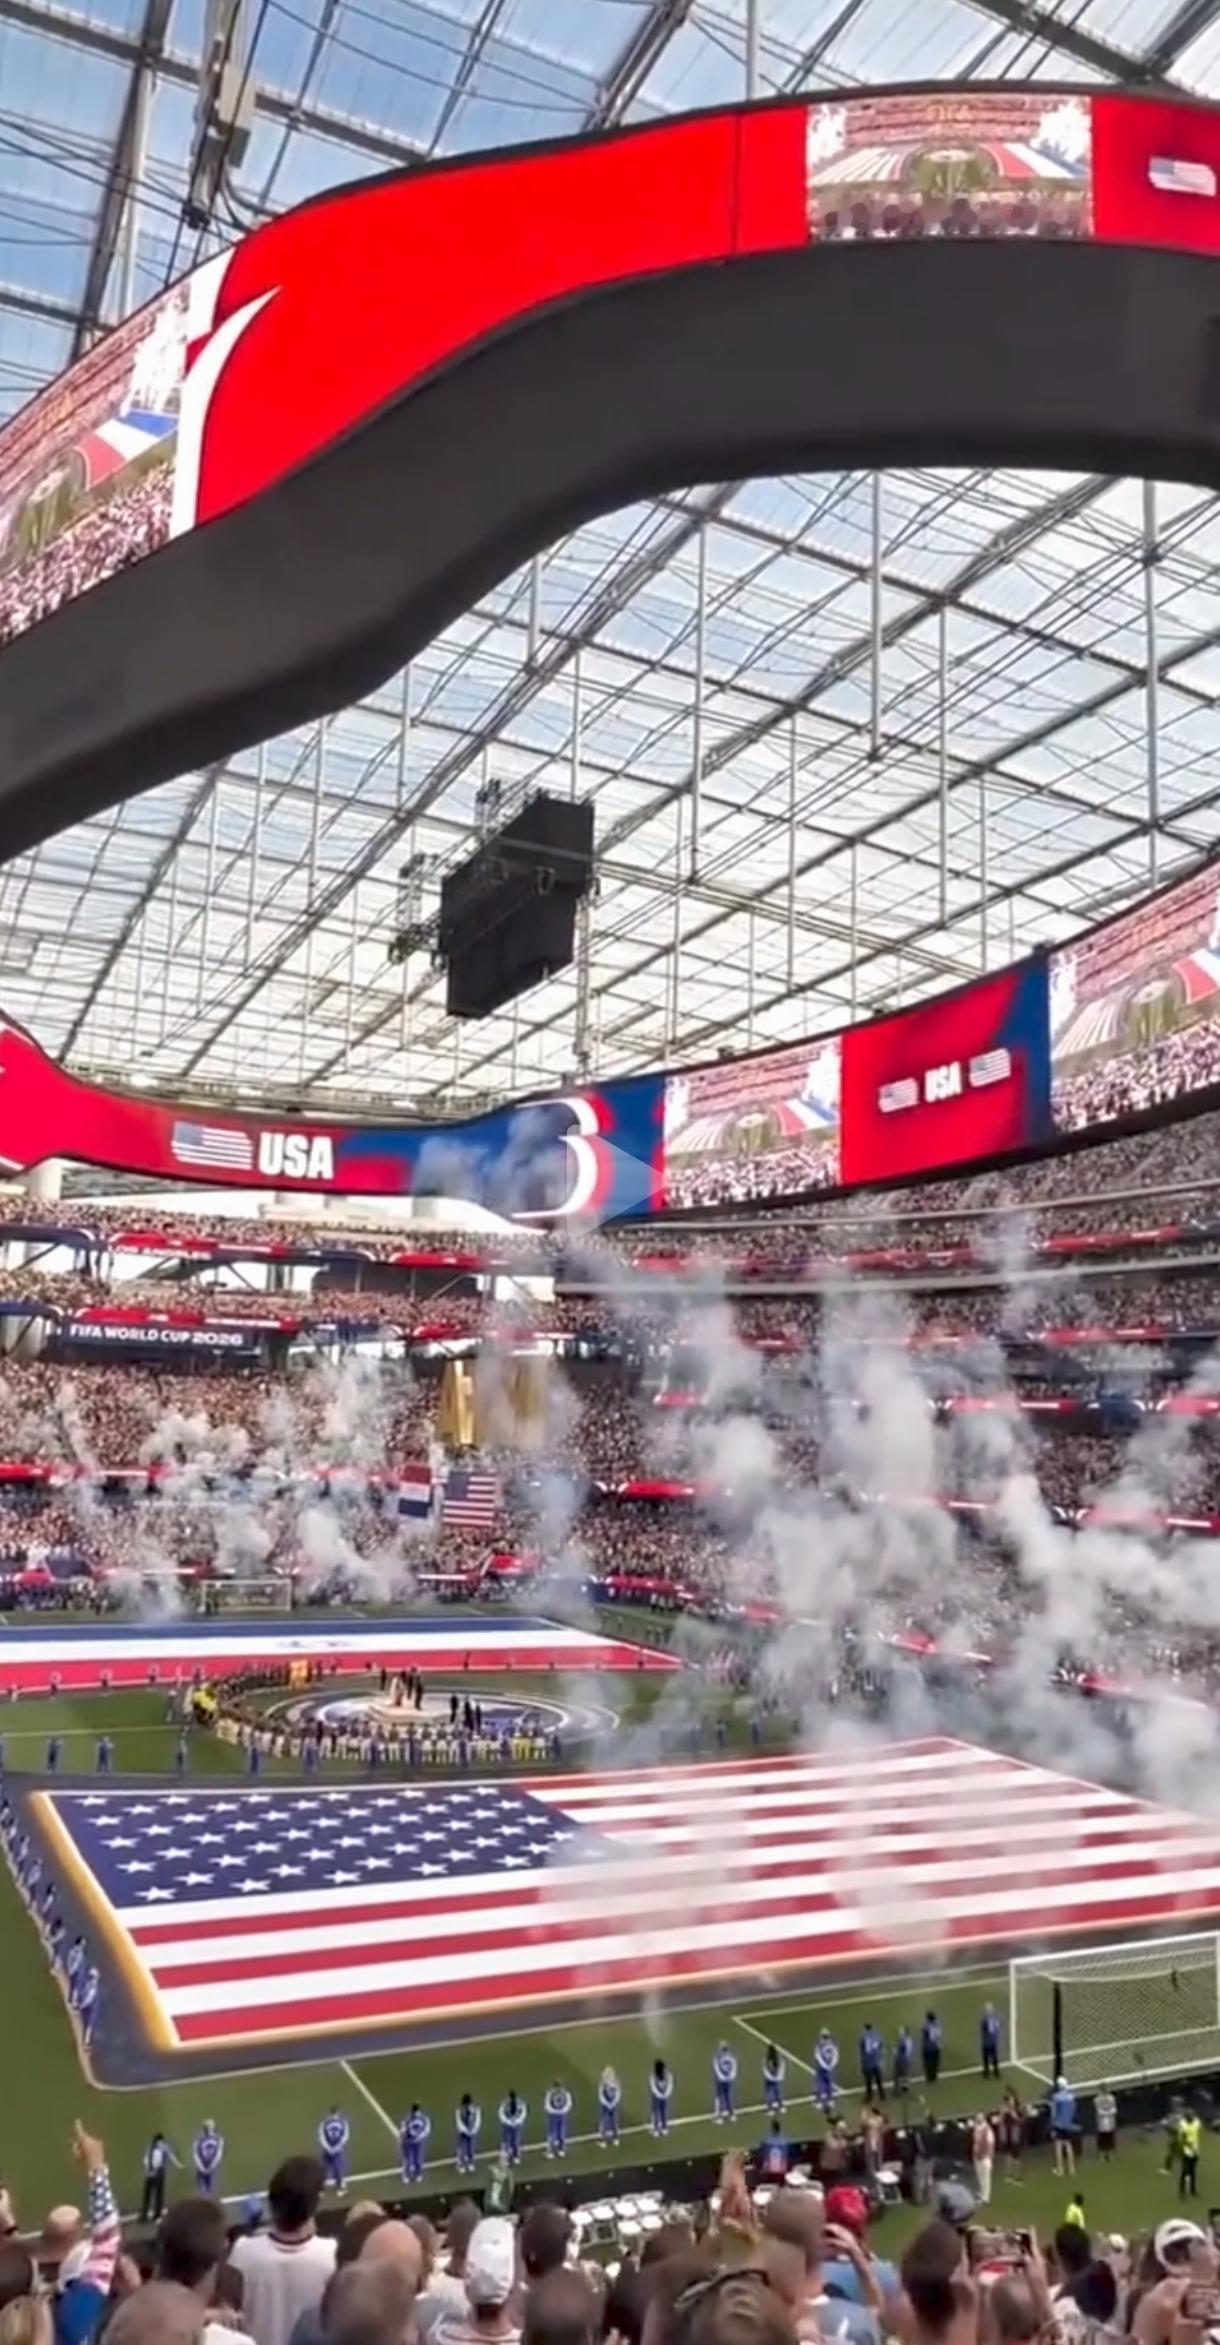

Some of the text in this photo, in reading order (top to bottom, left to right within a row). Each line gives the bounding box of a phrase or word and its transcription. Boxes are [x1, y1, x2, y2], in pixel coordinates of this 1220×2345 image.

[924, 1061, 962, 1103] USA
[259, 1131, 334, 1180] USA
[69, 1323, 244, 1347] FIFA WORLD CUP 2026
